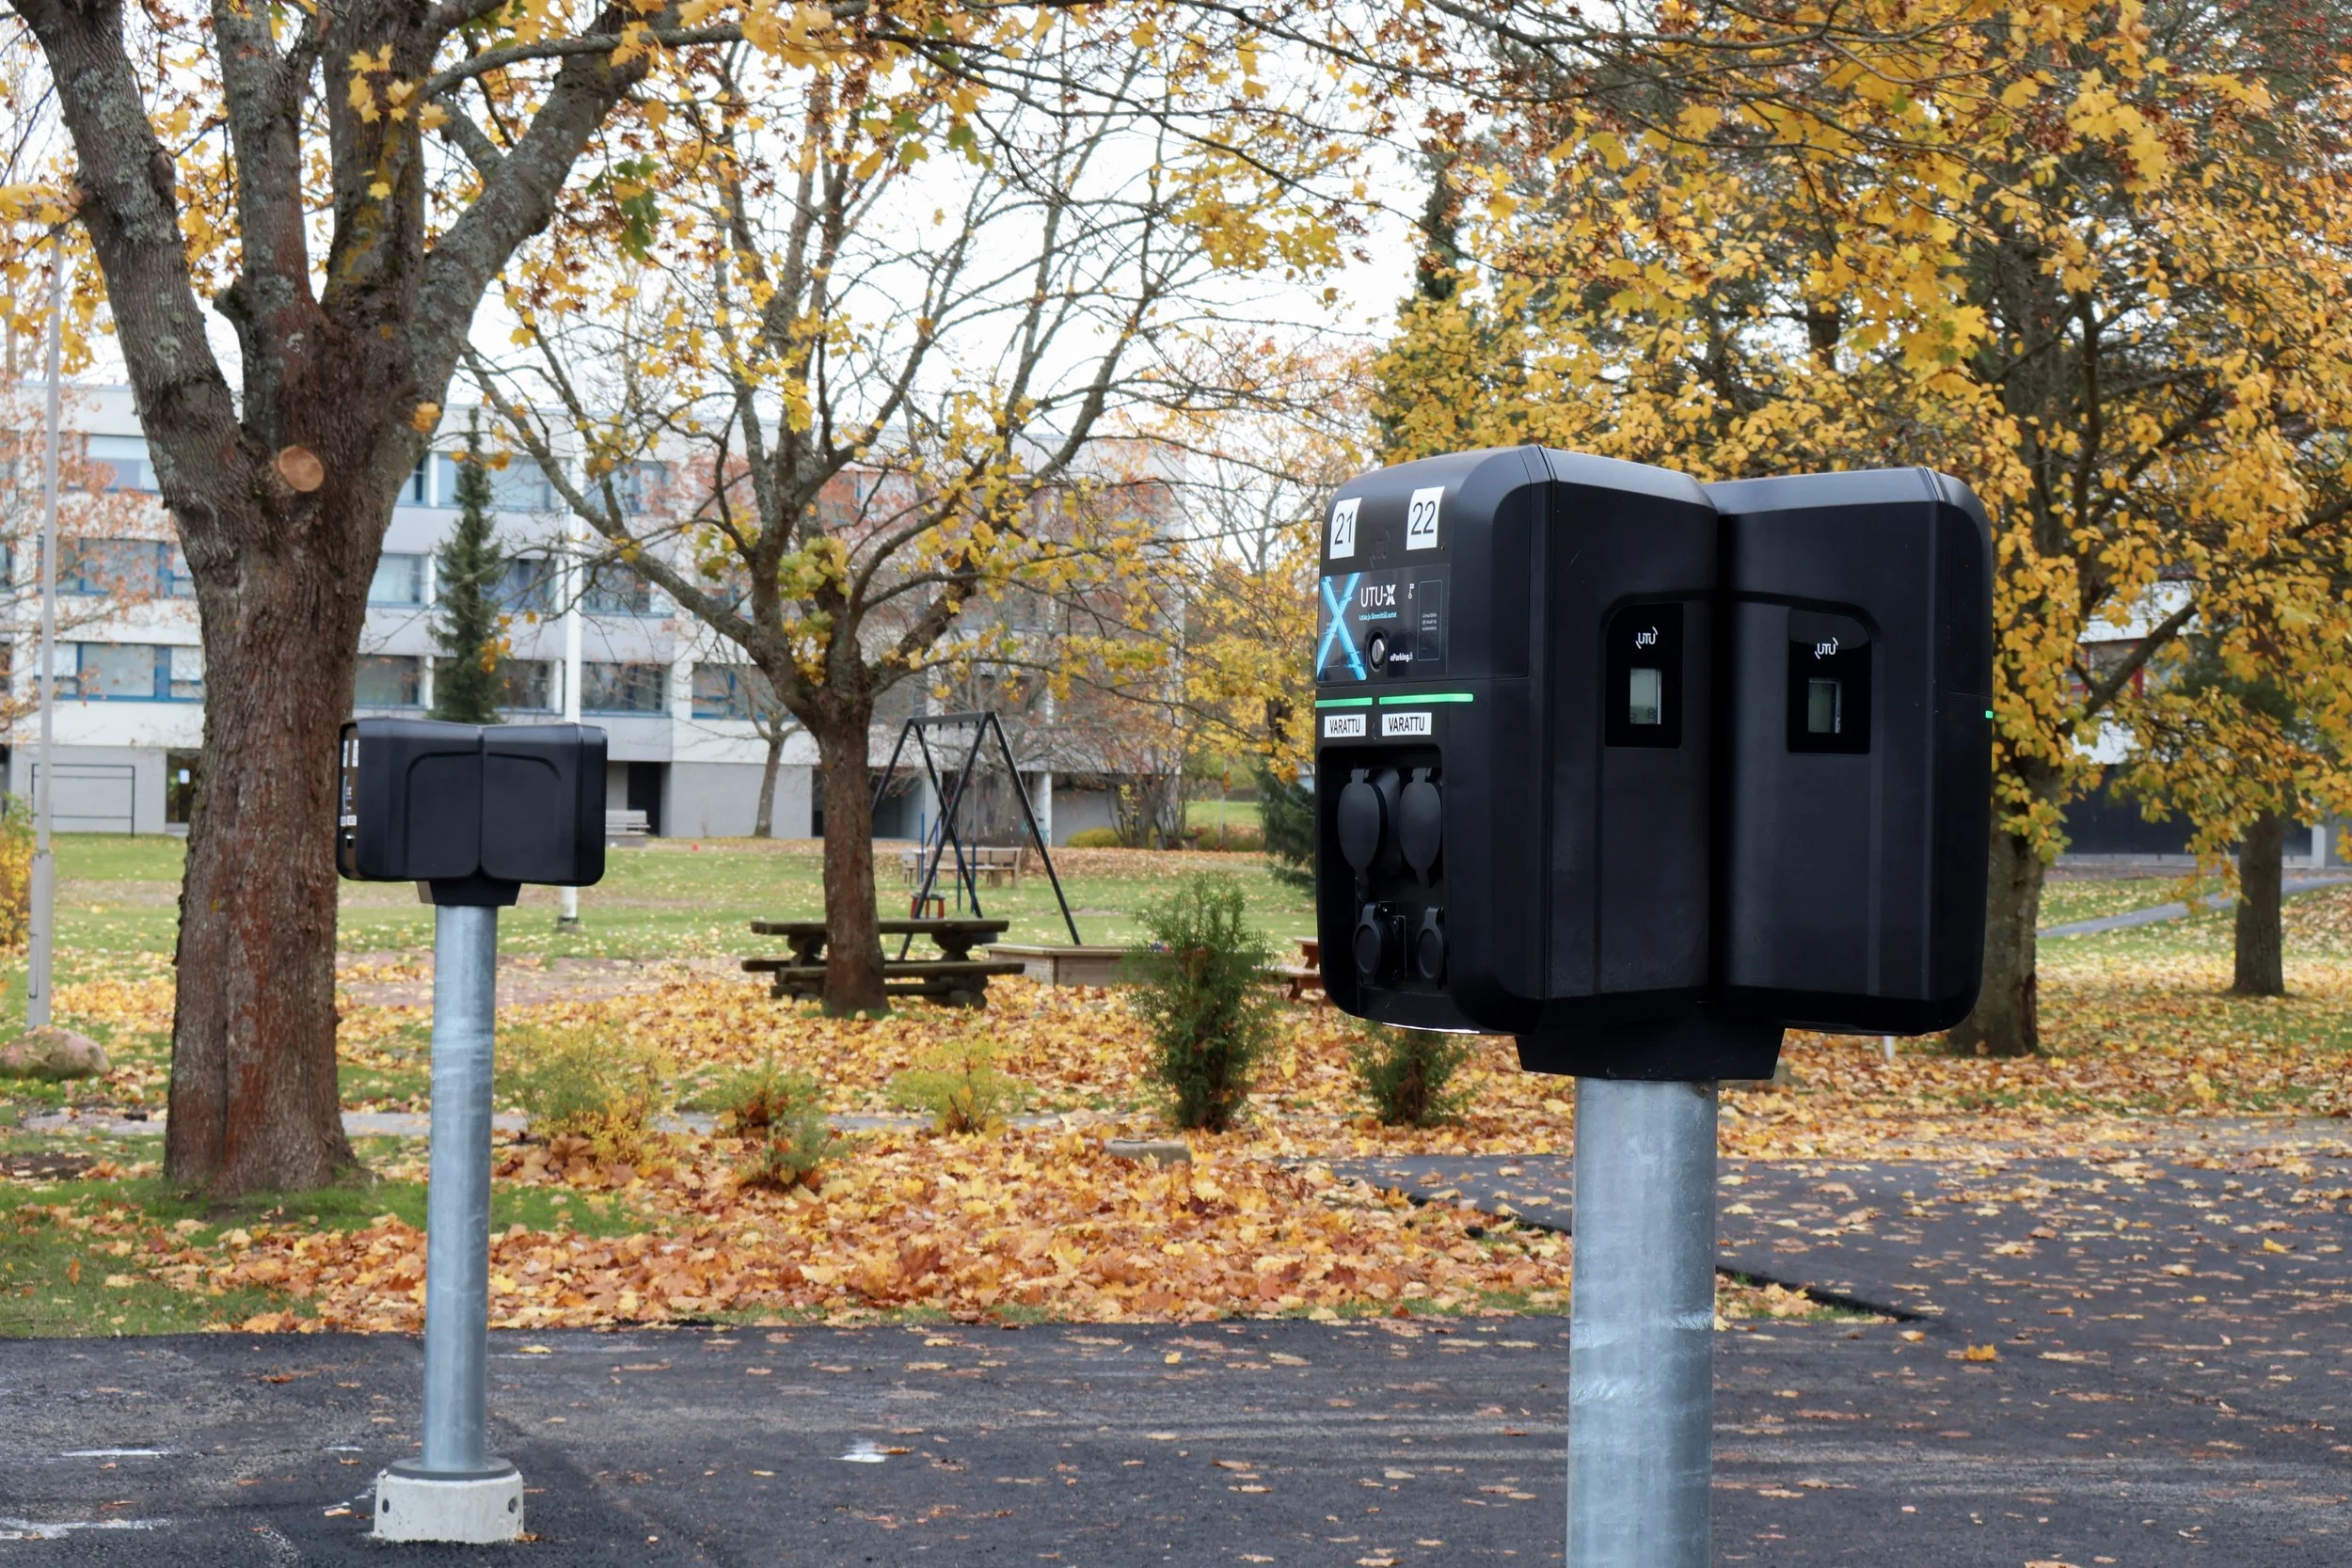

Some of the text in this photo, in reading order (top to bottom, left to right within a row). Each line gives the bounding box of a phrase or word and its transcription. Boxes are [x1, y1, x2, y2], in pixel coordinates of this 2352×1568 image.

[1410, 500, 1436, 535] 22
[1334, 511, 1354, 545] 21
[1360, 583, 1396, 608] UTU-X
[1637, 631, 1657, 645] UTU
[1816, 641, 1837, 656] UTU
[1329, 718, 1360, 735] VARATTU
[1389, 716, 1425, 733] VARATTU
